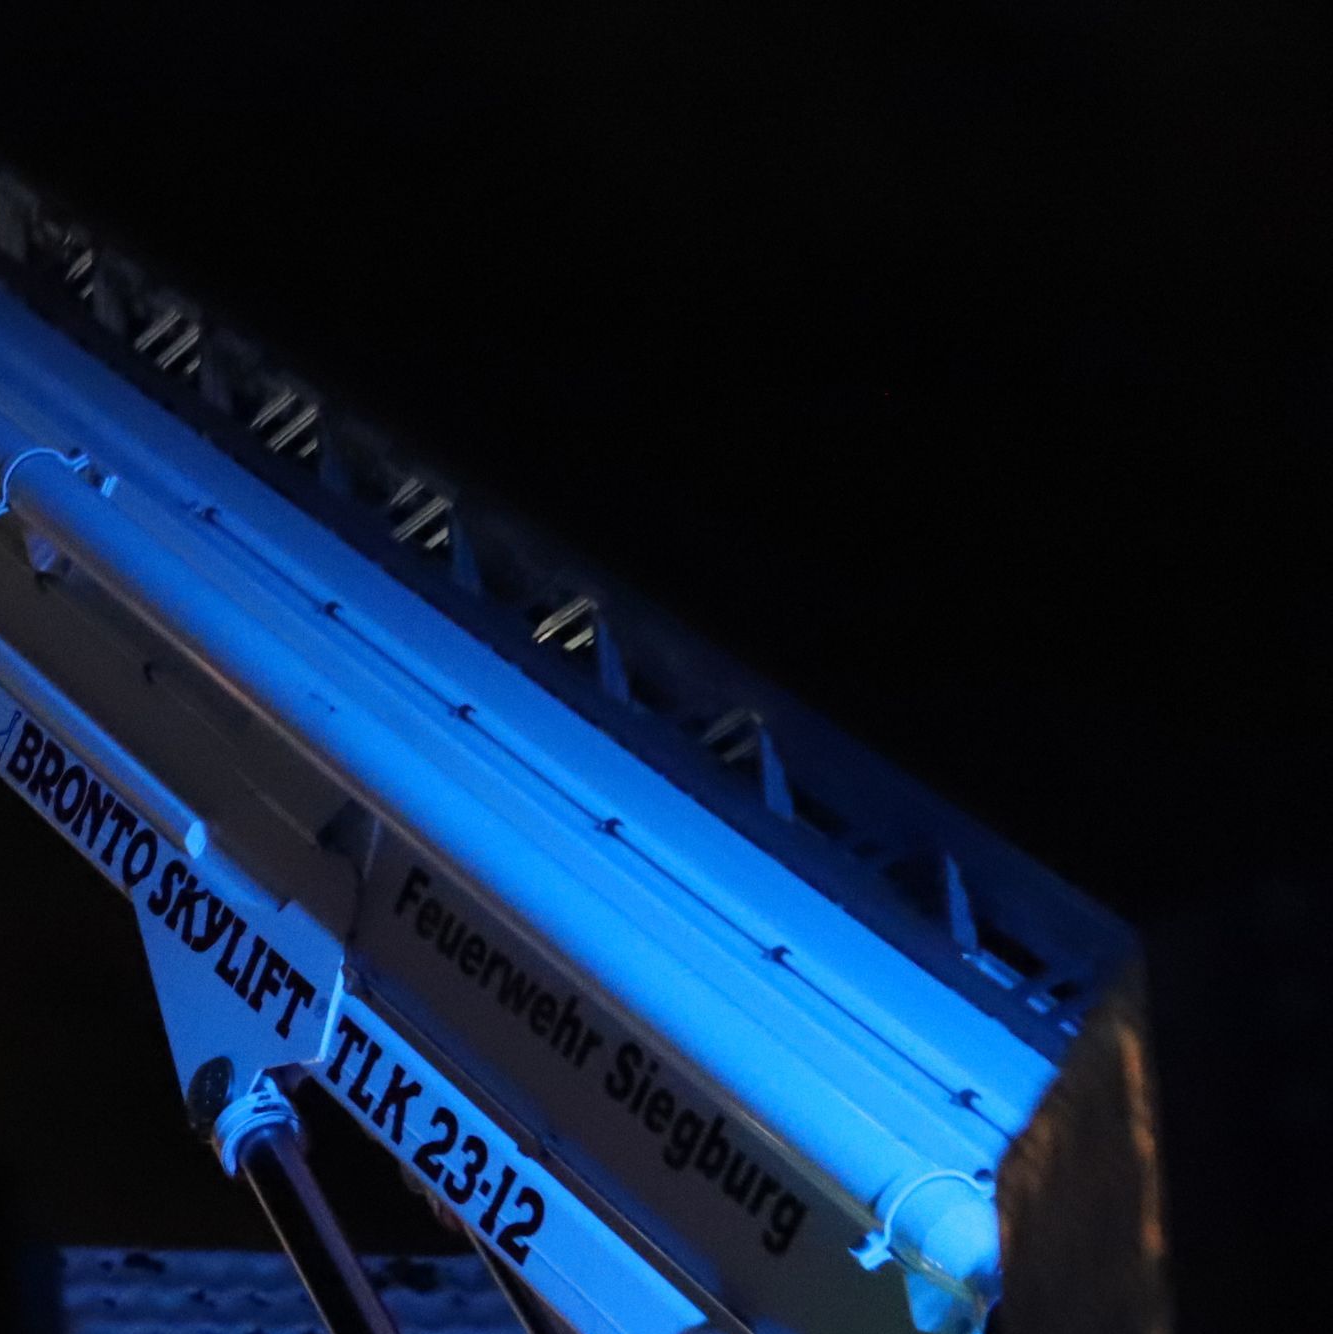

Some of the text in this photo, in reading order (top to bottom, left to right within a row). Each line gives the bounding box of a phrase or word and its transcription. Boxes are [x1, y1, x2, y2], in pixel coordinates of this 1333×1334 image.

[6, 723, 159, 887] BRONTO
[147, 859, 317, 1039] SKYLIFT
[326, 1015, 423, 1145] TLK
[393, 865, 809, 1257] Feuerwehr Siegburg
